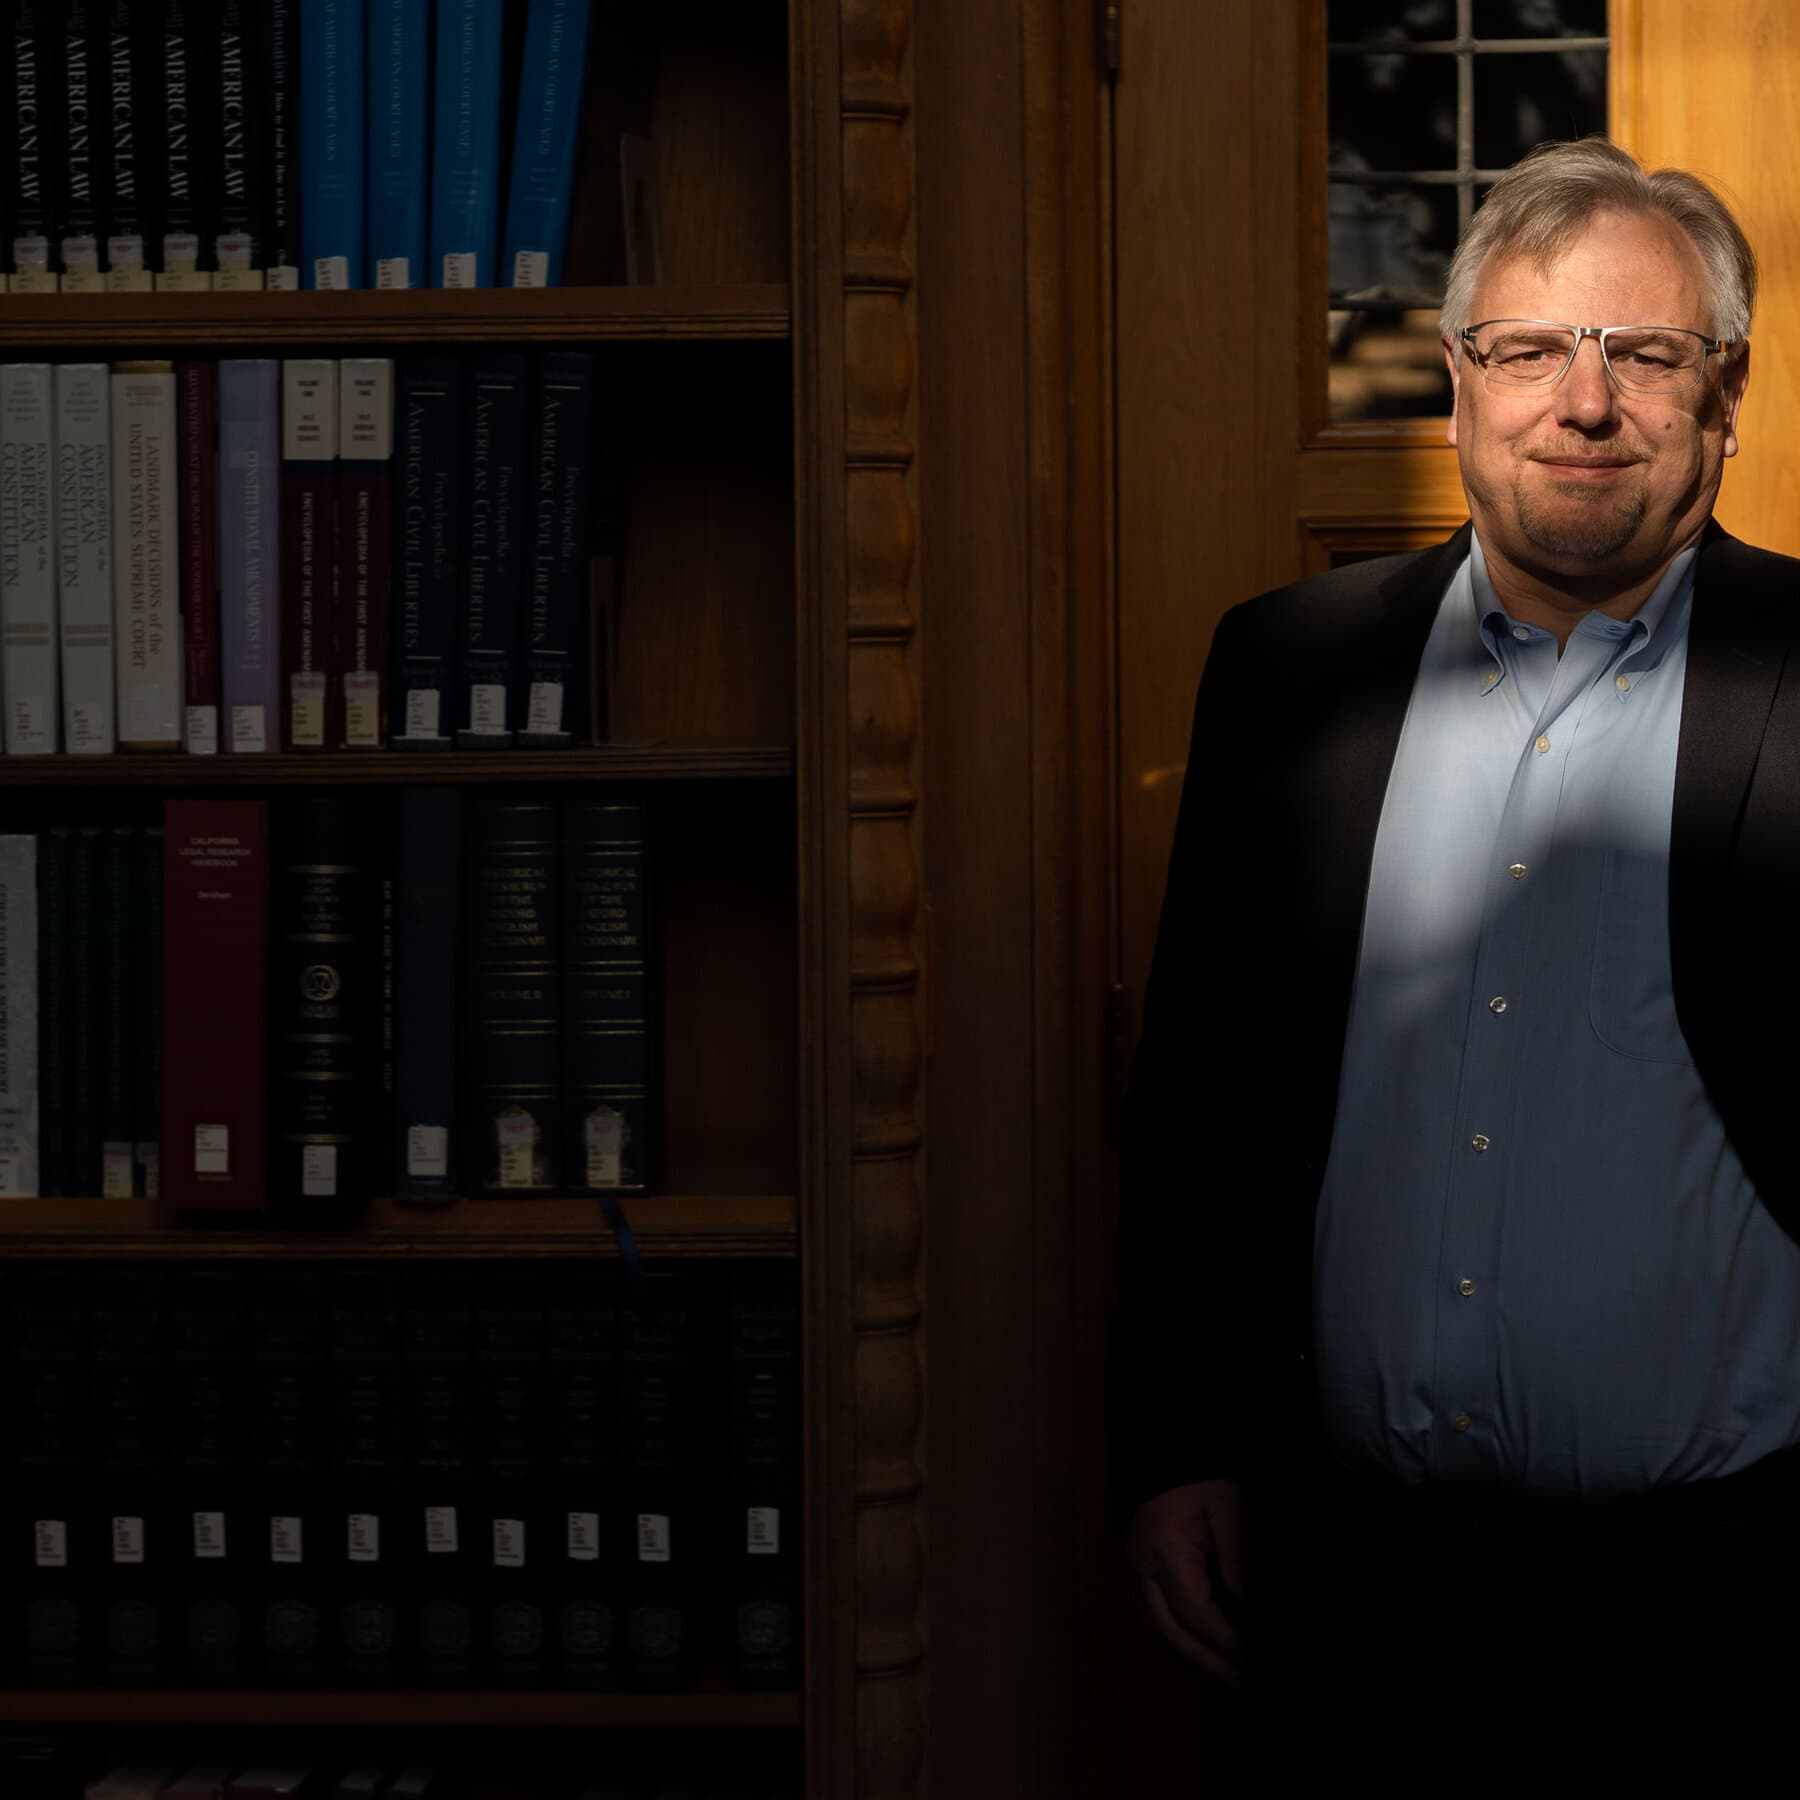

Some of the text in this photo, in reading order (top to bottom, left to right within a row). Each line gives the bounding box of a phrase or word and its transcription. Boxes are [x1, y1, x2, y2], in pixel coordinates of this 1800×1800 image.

[16, 34, 39, 152] AMERICAN
[67, 34, 89, 152] AMERICAN
[110, 31, 133, 150] AMERICAN
[164, 33, 188, 151] AMERICAN
[220, 31, 244, 150] AMERICAN
[20, 155, 40, 202] LAW
[70, 155, 91, 202] LAW
[115, 154, 135, 200] LAW
[168, 154, 190, 200] LAW
[224, 153, 246, 199] LAW
[20, 441, 37, 543] AMERICAN
[37, 442, 49, 542] ENCYCLOPEDIA
[79, 443, 97, 545] AMERICAN
[95, 443, 108, 543] ENCYCLOPEDIA
[127, 423, 144, 479] UNITED
[2, 442, 20, 588] CONSTITUTION
[61, 443, 80, 588] CONSTITUTION
[129, 484, 144, 539] STATES
[145, 435, 163, 656] LANDMARK DECISIONS of the
[244, 449, 261, 552] CONSTITUTIONAL
[301, 491, 313, 562] ENCYCLOPEDIA
[357, 491, 369, 562] ENCYCLOPEDIA
[404, 401, 426, 649] AMERICAN CIVIL LIBERTIES
[432, 472, 449, 564] Encyclopedia
[469, 394, 496, 641] AMERICAN CIVIL LIBERTIES
[495, 465, 512, 561] Encyclopedia
[531, 396, 562, 642] AMERICAN CIVIL LIBERTIES
[559, 465, 581, 560] Encyclopedia
[130, 544, 145, 614] SUPREME
[245, 558, 262, 642] AMENDMENTS
[301, 564, 312, 576] OF
[301, 580, 312, 597] THE
[301, 600, 312, 625] FIRST
[357, 564, 368, 576] OF
[357, 580, 368, 597] THE
[357, 600, 368, 625] FIRST
[131, 619, 147, 670] COURT
